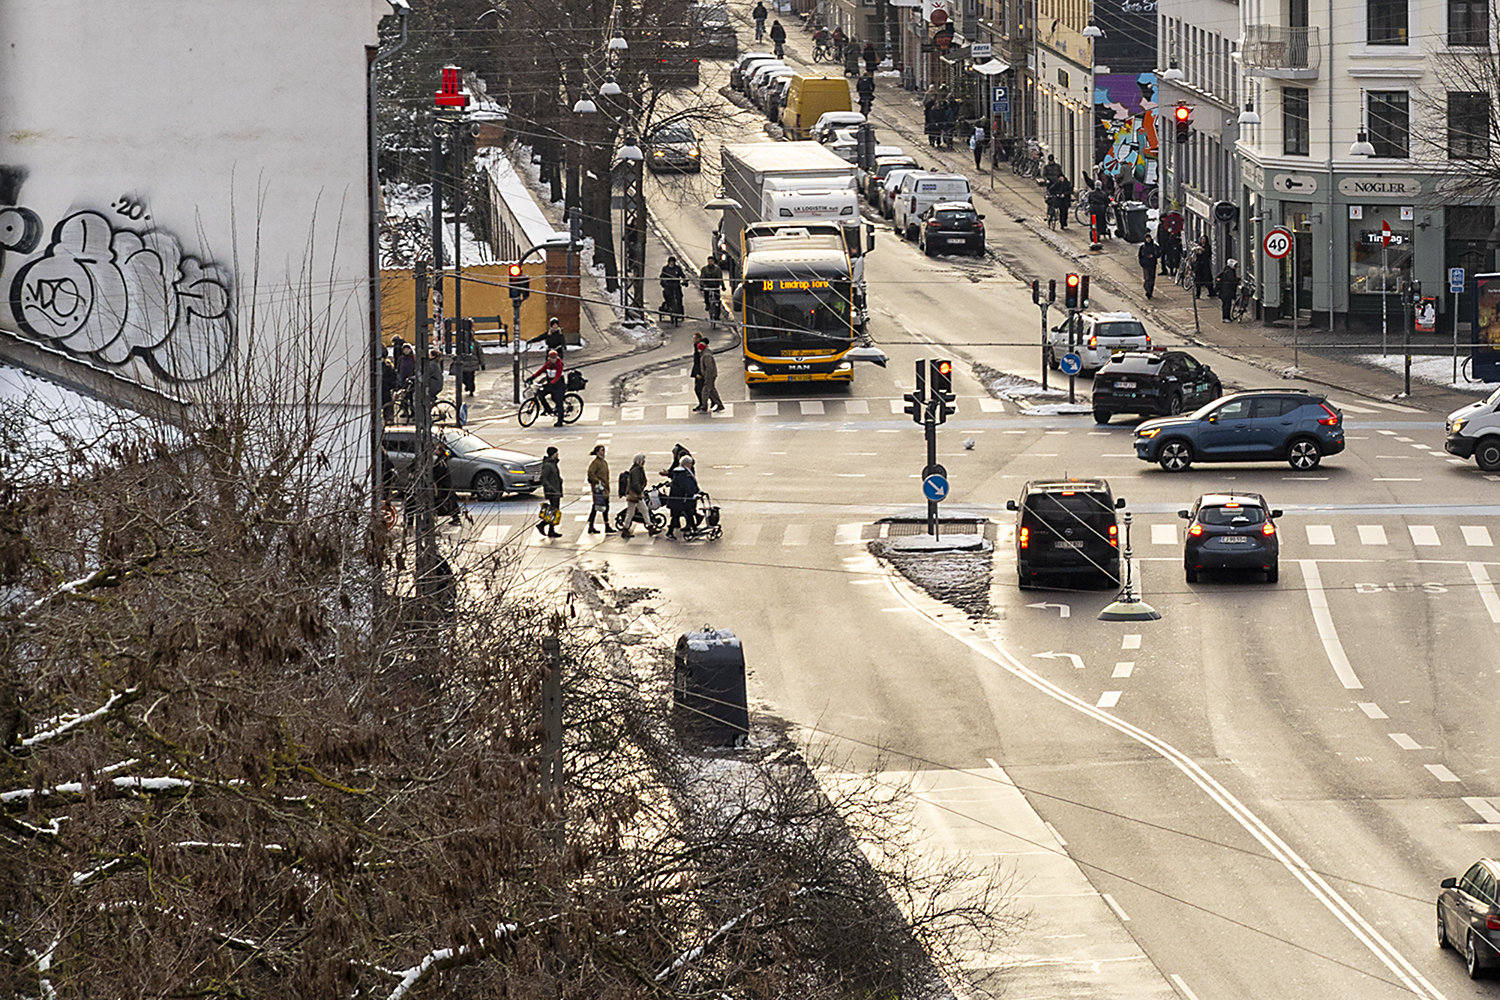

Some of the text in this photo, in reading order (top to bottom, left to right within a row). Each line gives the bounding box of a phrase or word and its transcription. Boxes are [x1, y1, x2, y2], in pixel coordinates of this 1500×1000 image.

[996, 89, 1004, 101] P
[1354, 182, 1405, 193] NØGLER
[1268, 238, 1287, 250] 40
[763, 280, 773, 291] 18
[1354, 581, 1449, 594] BUS
